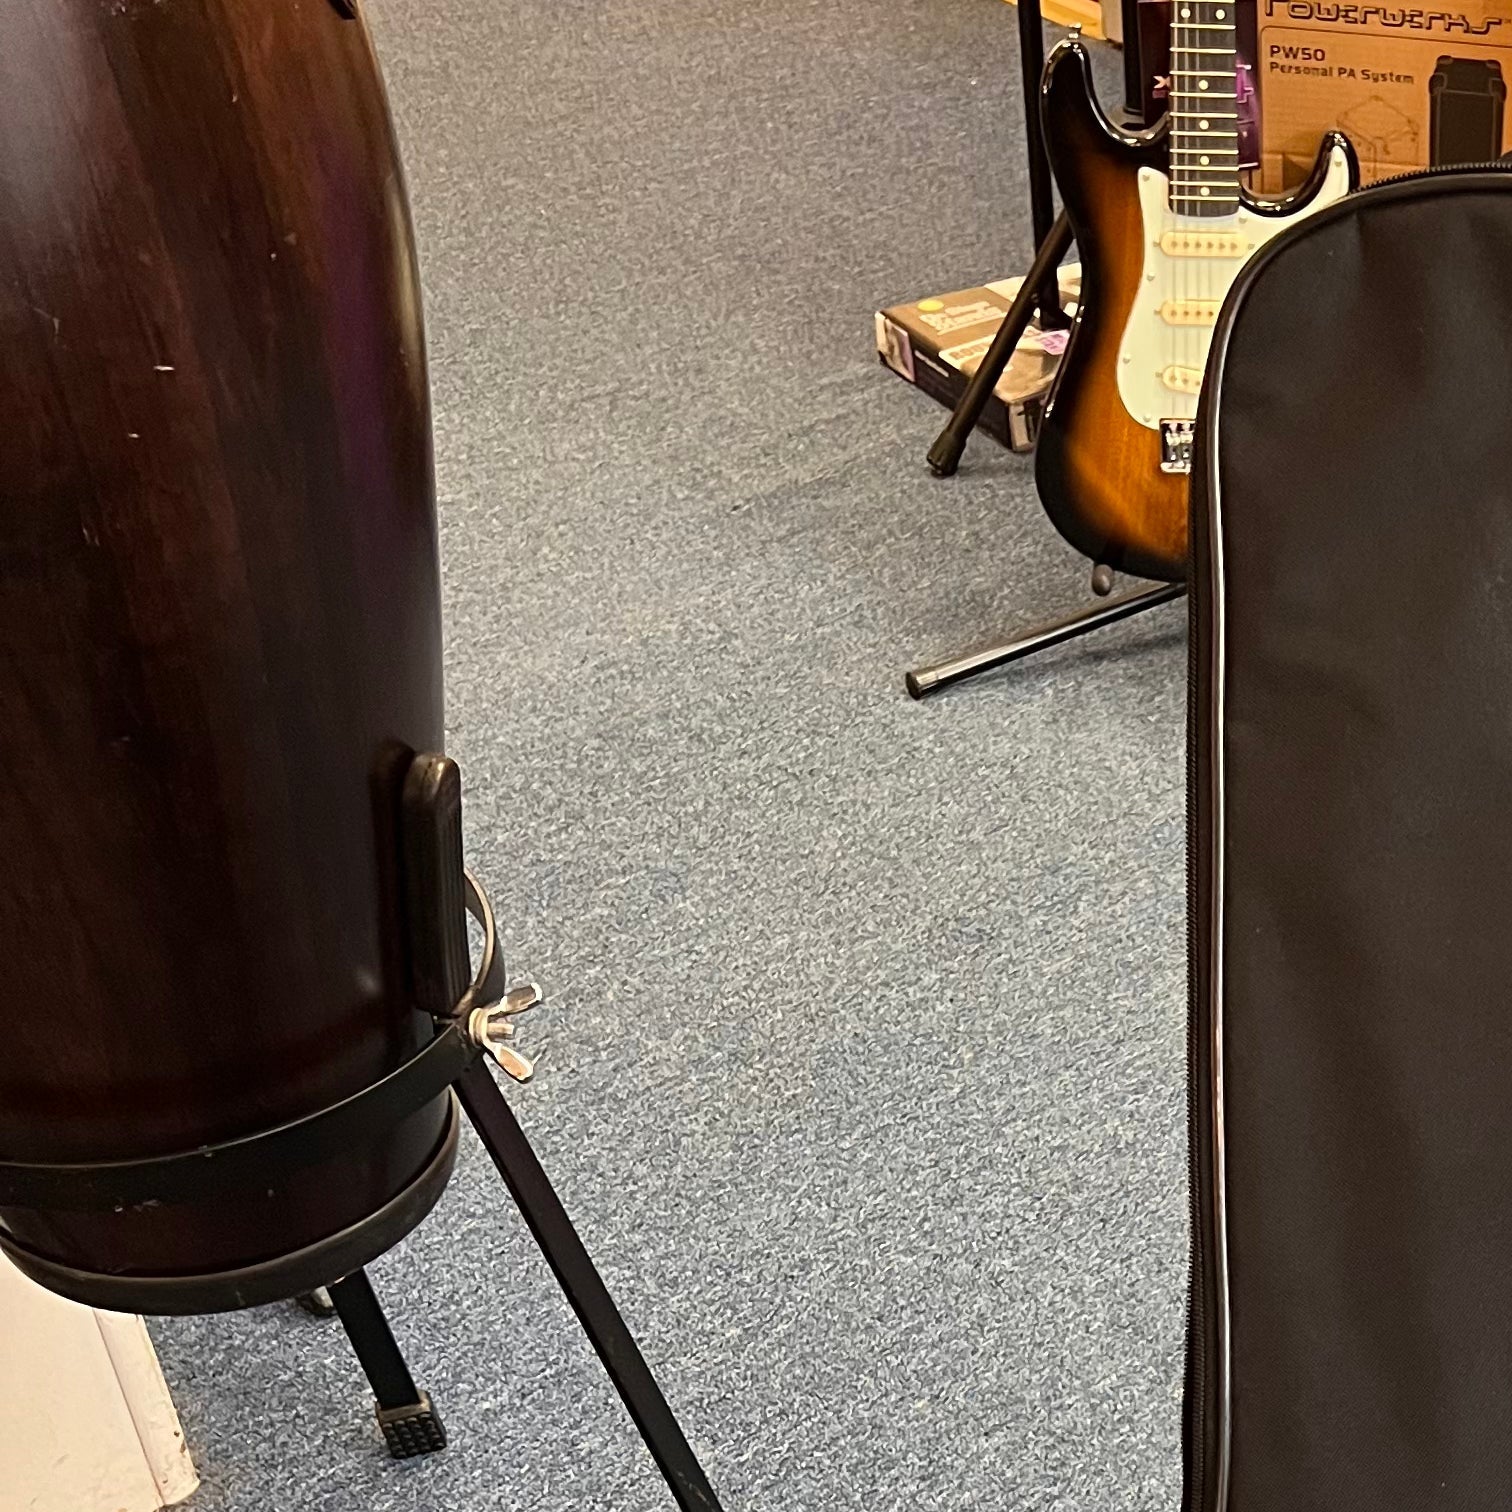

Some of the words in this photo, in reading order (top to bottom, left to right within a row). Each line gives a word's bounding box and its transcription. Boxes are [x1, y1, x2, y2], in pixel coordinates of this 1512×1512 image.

[1270, 45, 1326, 61] PW50
[1269, 62, 1333, 77] Personal
[1337, 67, 1356, 79] PA
[1360, 69, 1414, 84] System
